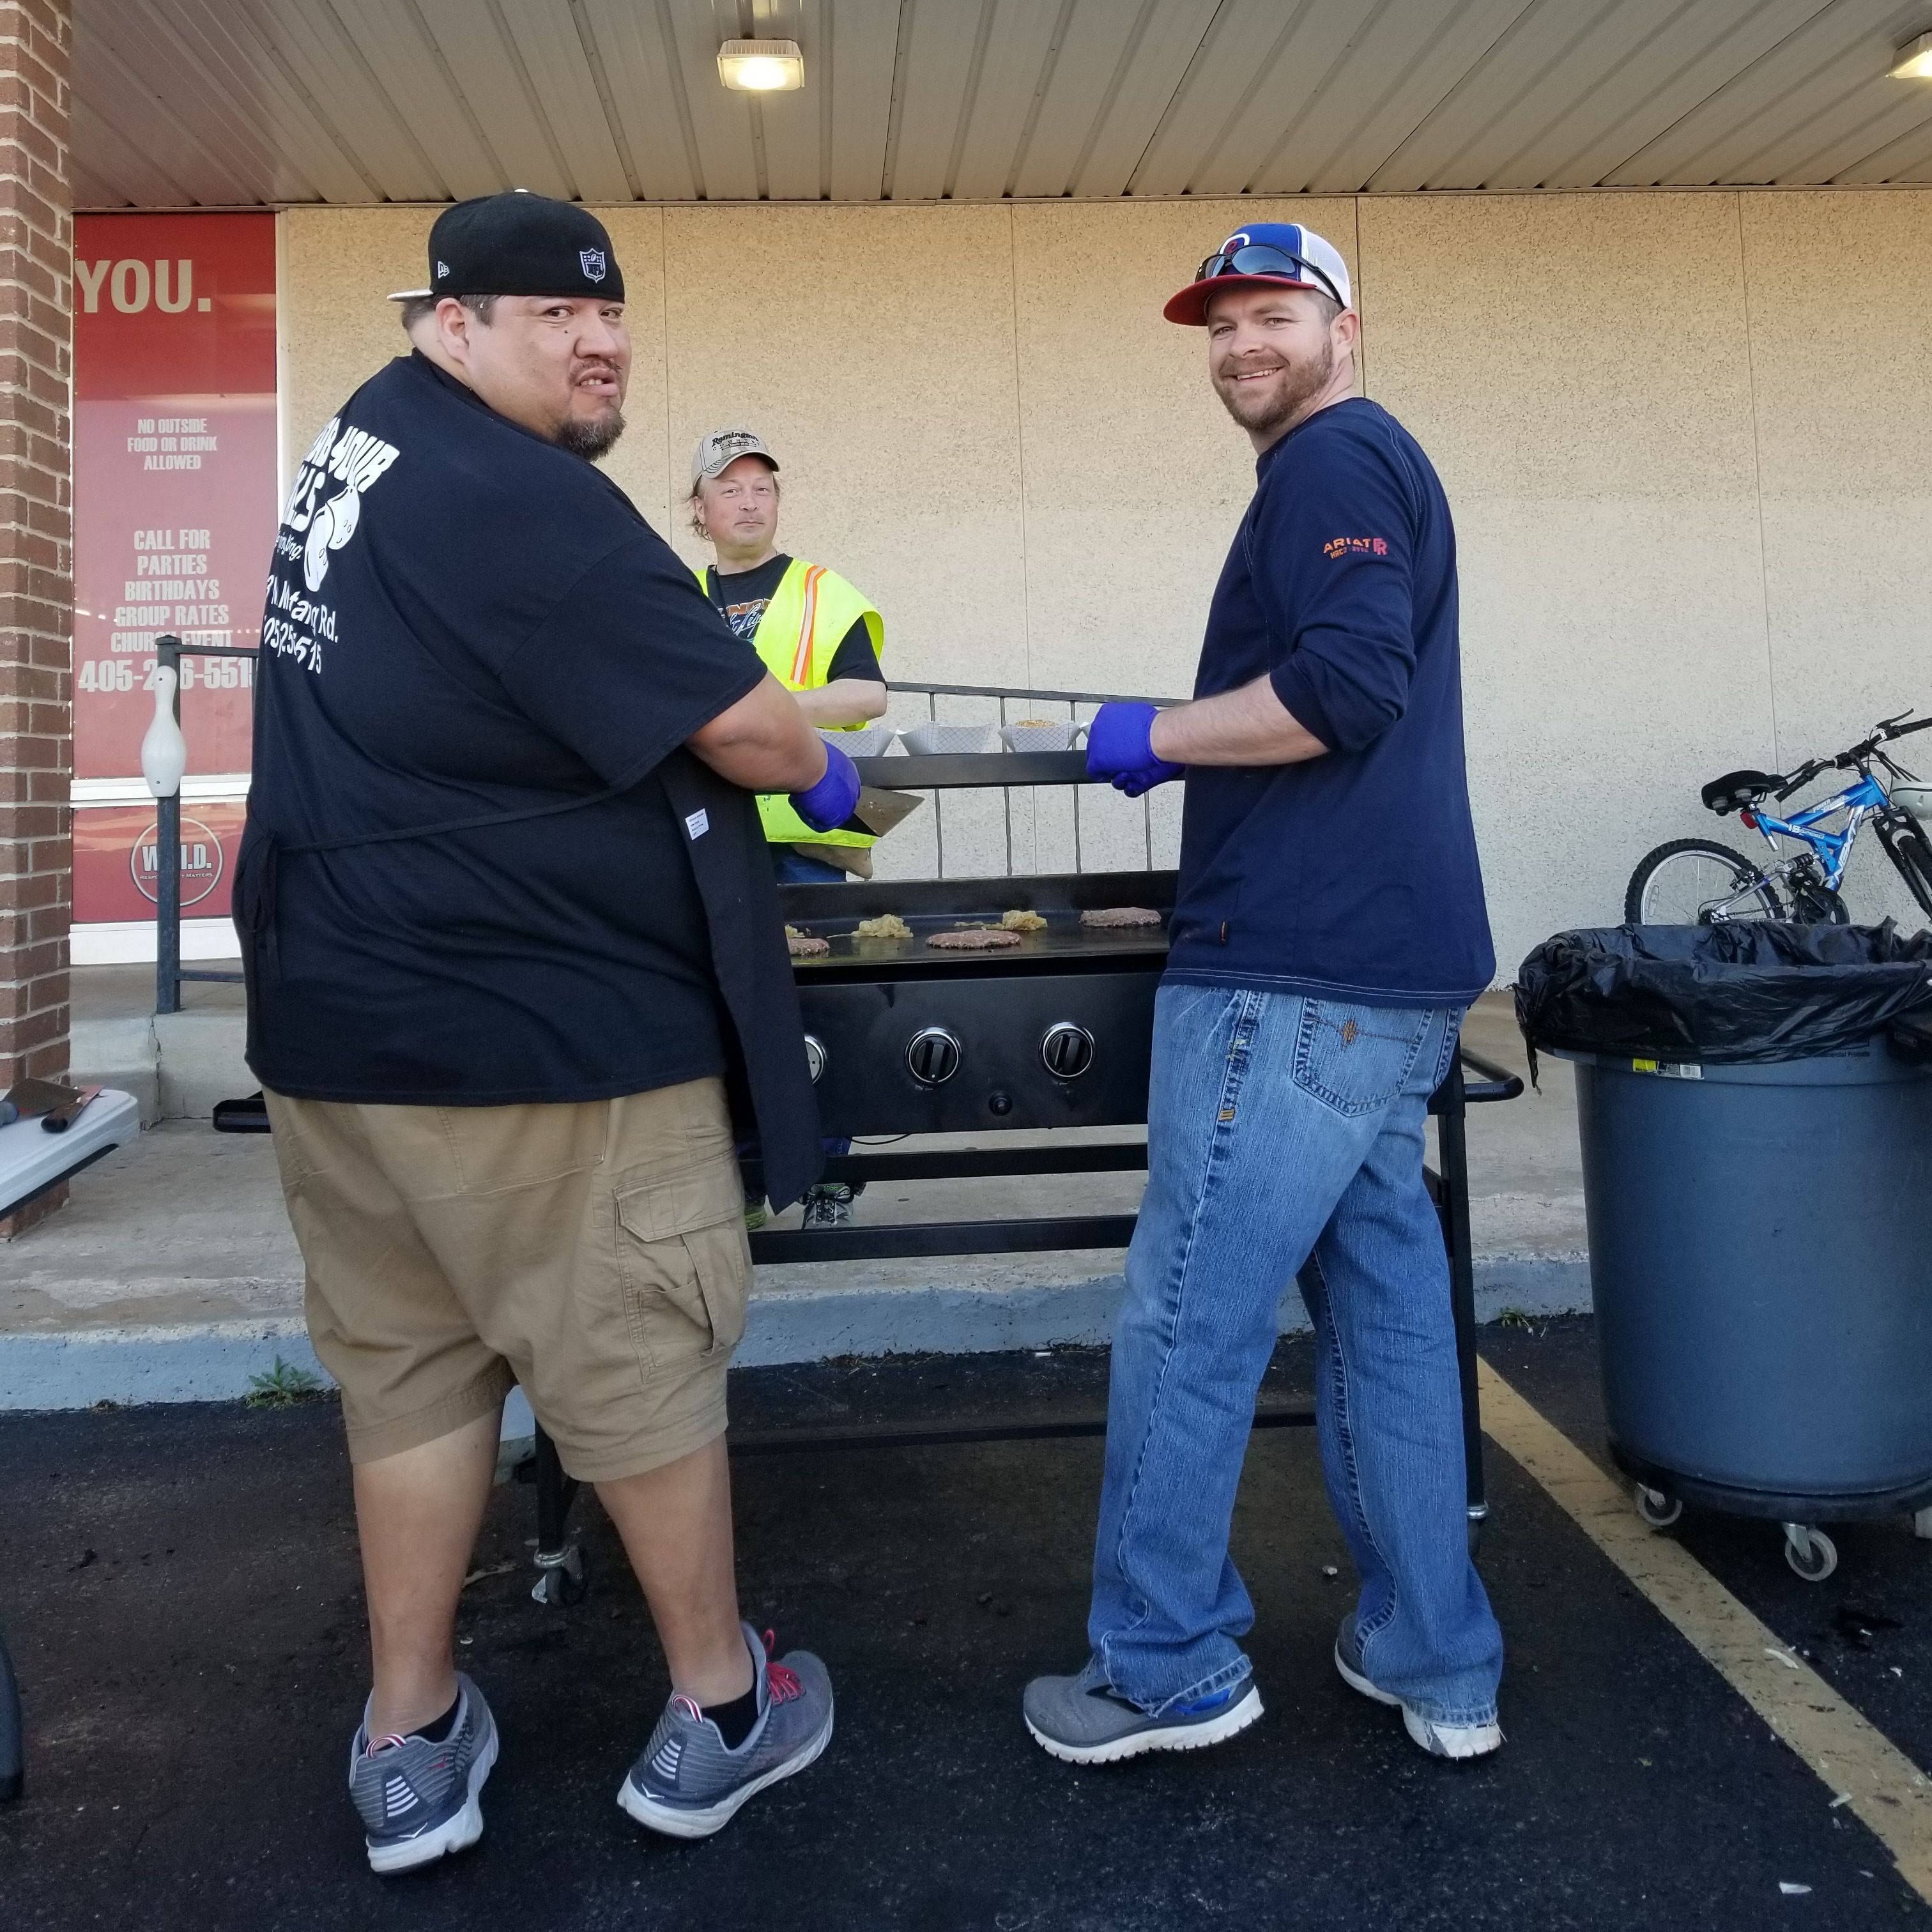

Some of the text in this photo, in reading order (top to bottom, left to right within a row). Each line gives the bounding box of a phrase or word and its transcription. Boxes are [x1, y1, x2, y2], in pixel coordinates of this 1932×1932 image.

[74, 259, 211, 313] YOU.
[137, 418, 207, 434] NO OUTSIDE
[127, 436, 217, 452] FOOD OR DRINK
[712, 431, 759, 447] Remington
[144, 455, 201, 470] ALLOWED
[134, 529, 210, 550] CALL FOR
[1324, 538, 1370, 553] ARIAT
[137, 555, 208, 576] PARTIES
[125, 579, 220, 601] BIRTHDAYS
[115, 604, 229, 627] GROUP RATES
[318, 604, 338, 643] Rd.
[111, 631, 176, 652] CHUR
[78, 657, 253, 692] 405-26-551
